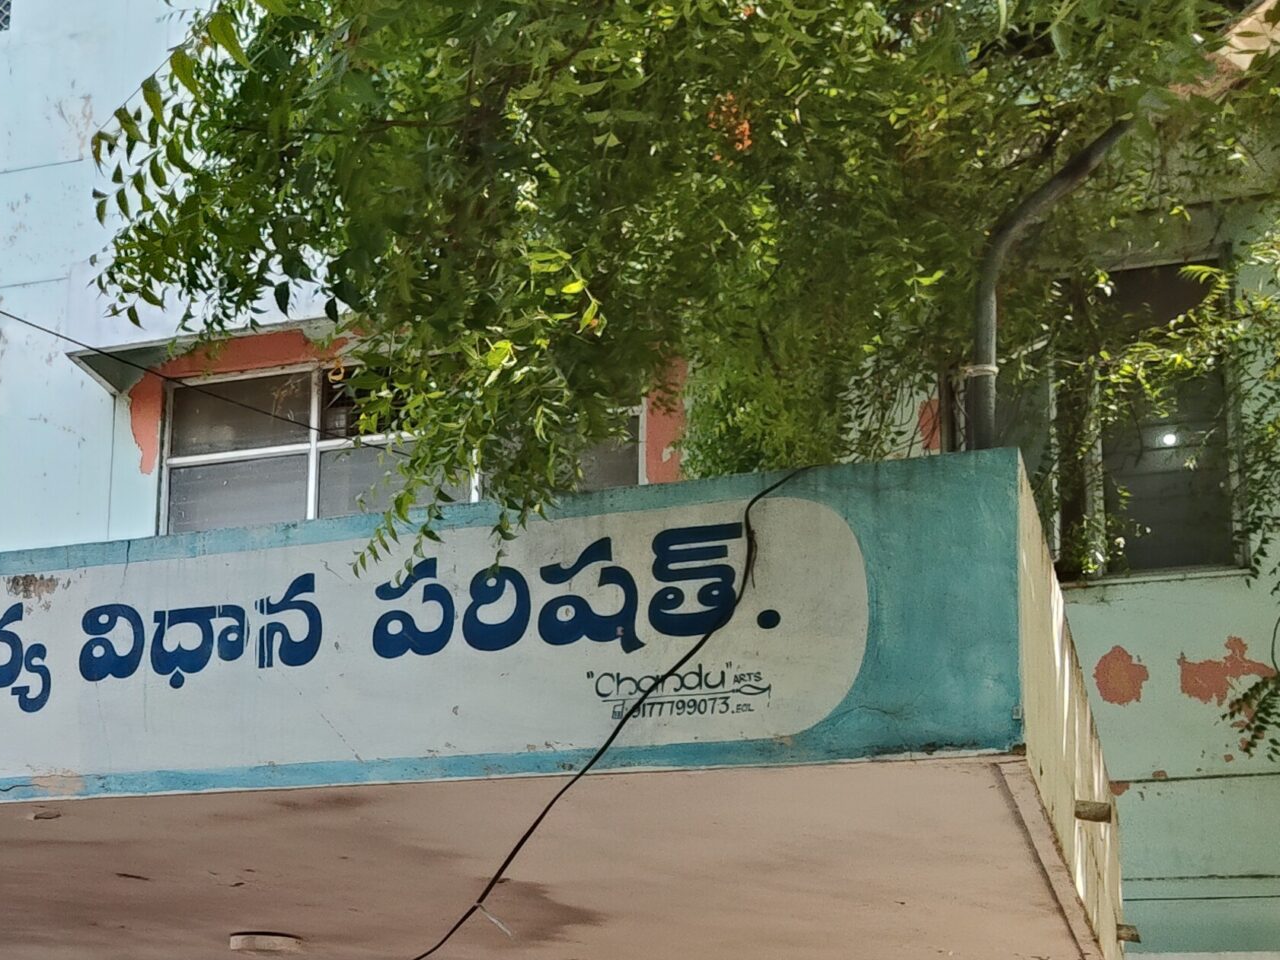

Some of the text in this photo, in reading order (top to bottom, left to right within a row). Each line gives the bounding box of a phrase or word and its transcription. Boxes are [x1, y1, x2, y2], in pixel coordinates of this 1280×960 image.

[78, 573, 323, 690] విధాన
[372, 522, 782, 660] పరిషత్.
[732, 671, 763, 685] ARTS
